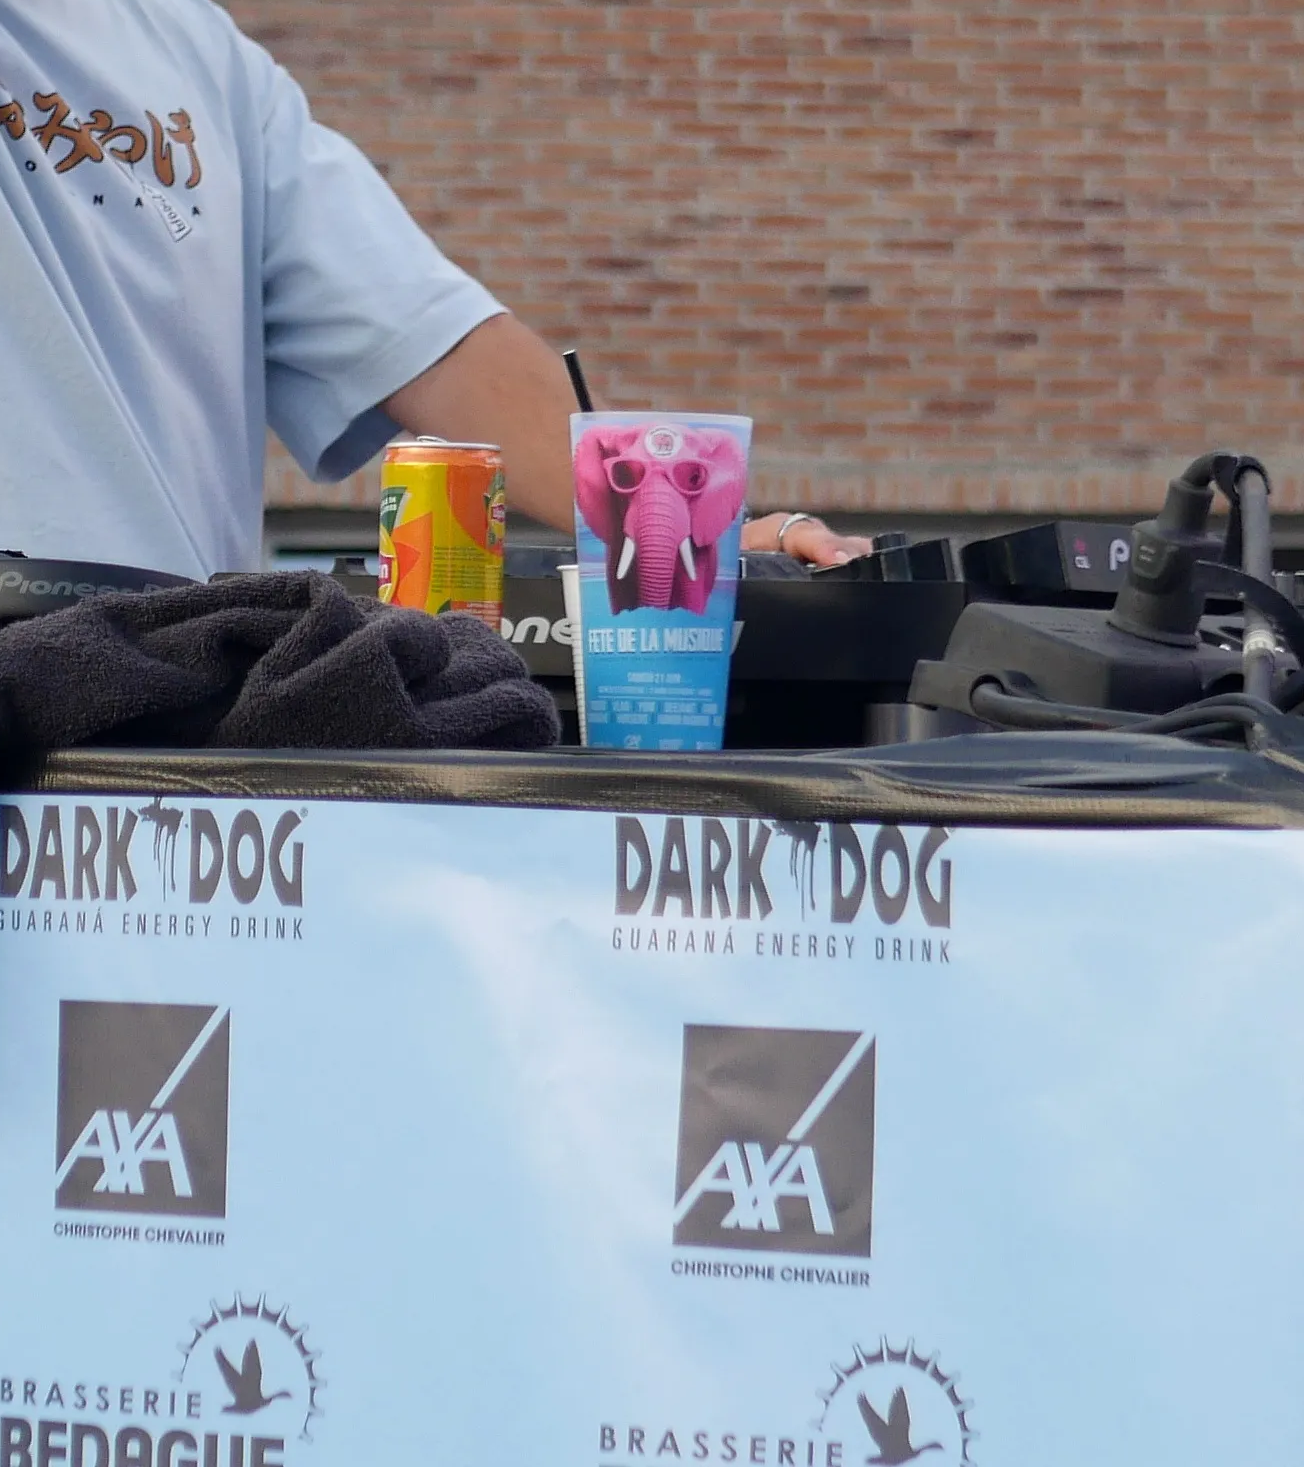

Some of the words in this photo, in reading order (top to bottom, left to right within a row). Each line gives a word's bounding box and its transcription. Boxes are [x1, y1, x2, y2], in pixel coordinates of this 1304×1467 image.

[617, 628, 636, 653] DE
[640, 628, 658, 653] LA
[189, 808, 304, 908] DOG
[615, 816, 773, 920] DARK
[828, 822, 952, 929] DOG
[123, 913, 212, 936] ENERGY
[231, 916, 304, 940] DRINK
[613, 926, 735, 955] GUARANÁ
[756, 933, 855, 958] ENERGY
[875, 938, 951, 963] DRINK
[55, 1110, 193, 1197] AXA
[673, 1141, 834, 1236] AXA
[54, 1221, 140, 1241] CHRISTOPHE
[144, 1227, 225, 1246] CHEVALIER
[671, 1260, 776, 1281] CHRISTOPHE
[780, 1267, 871, 1286] CHEVALIER
[0, 1378, 202, 1420] BRASSERIE
[598, 1423, 843, 1467] BRASSERIE
